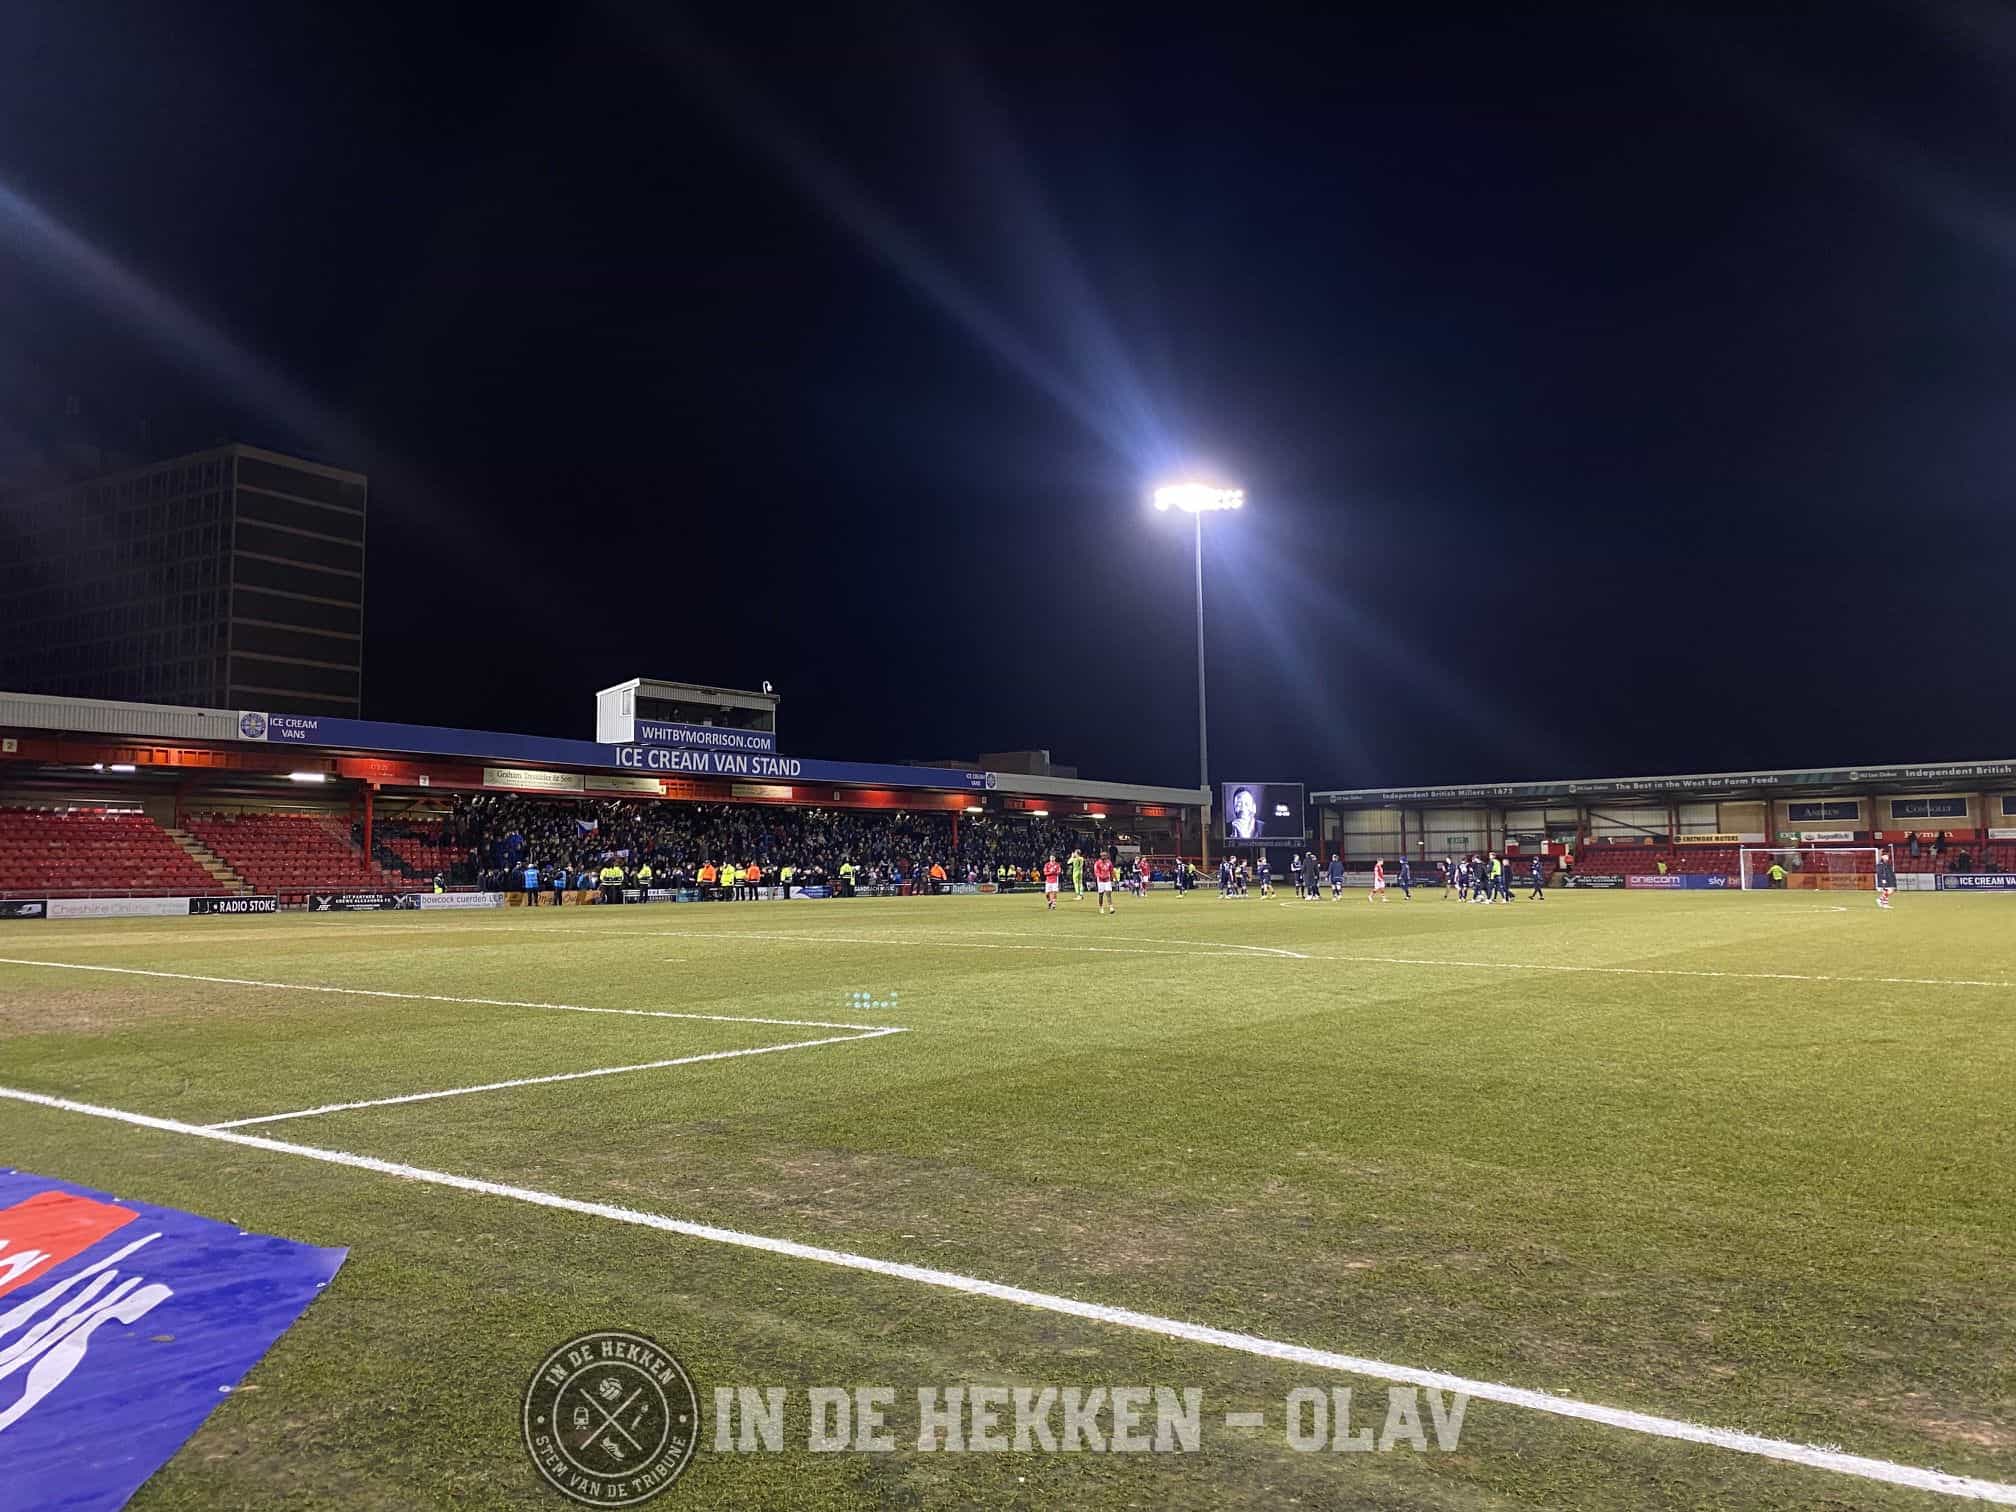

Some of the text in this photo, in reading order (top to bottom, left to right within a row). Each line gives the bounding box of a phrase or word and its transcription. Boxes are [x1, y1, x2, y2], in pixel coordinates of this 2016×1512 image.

[270, 718, 317, 728] ICE CREAM
[282, 729, 305, 738] VANS
[642, 726, 771, 749] WHITBYMORRISON.COM
[615, 747, 800, 776] ICE CREAM VAN STAND
[1905, 766, 2012, 778] Independent British
[1752, 776, 1778, 784] Feeds
[1383, 791, 1428, 800] Independent
[1707, 876, 1726, 886] sky
[1960, 876, 1974, 885] ICE
[1975, 876, 2005, 885] CREAM
[220, 900, 276, 912] RADIO STOKE
